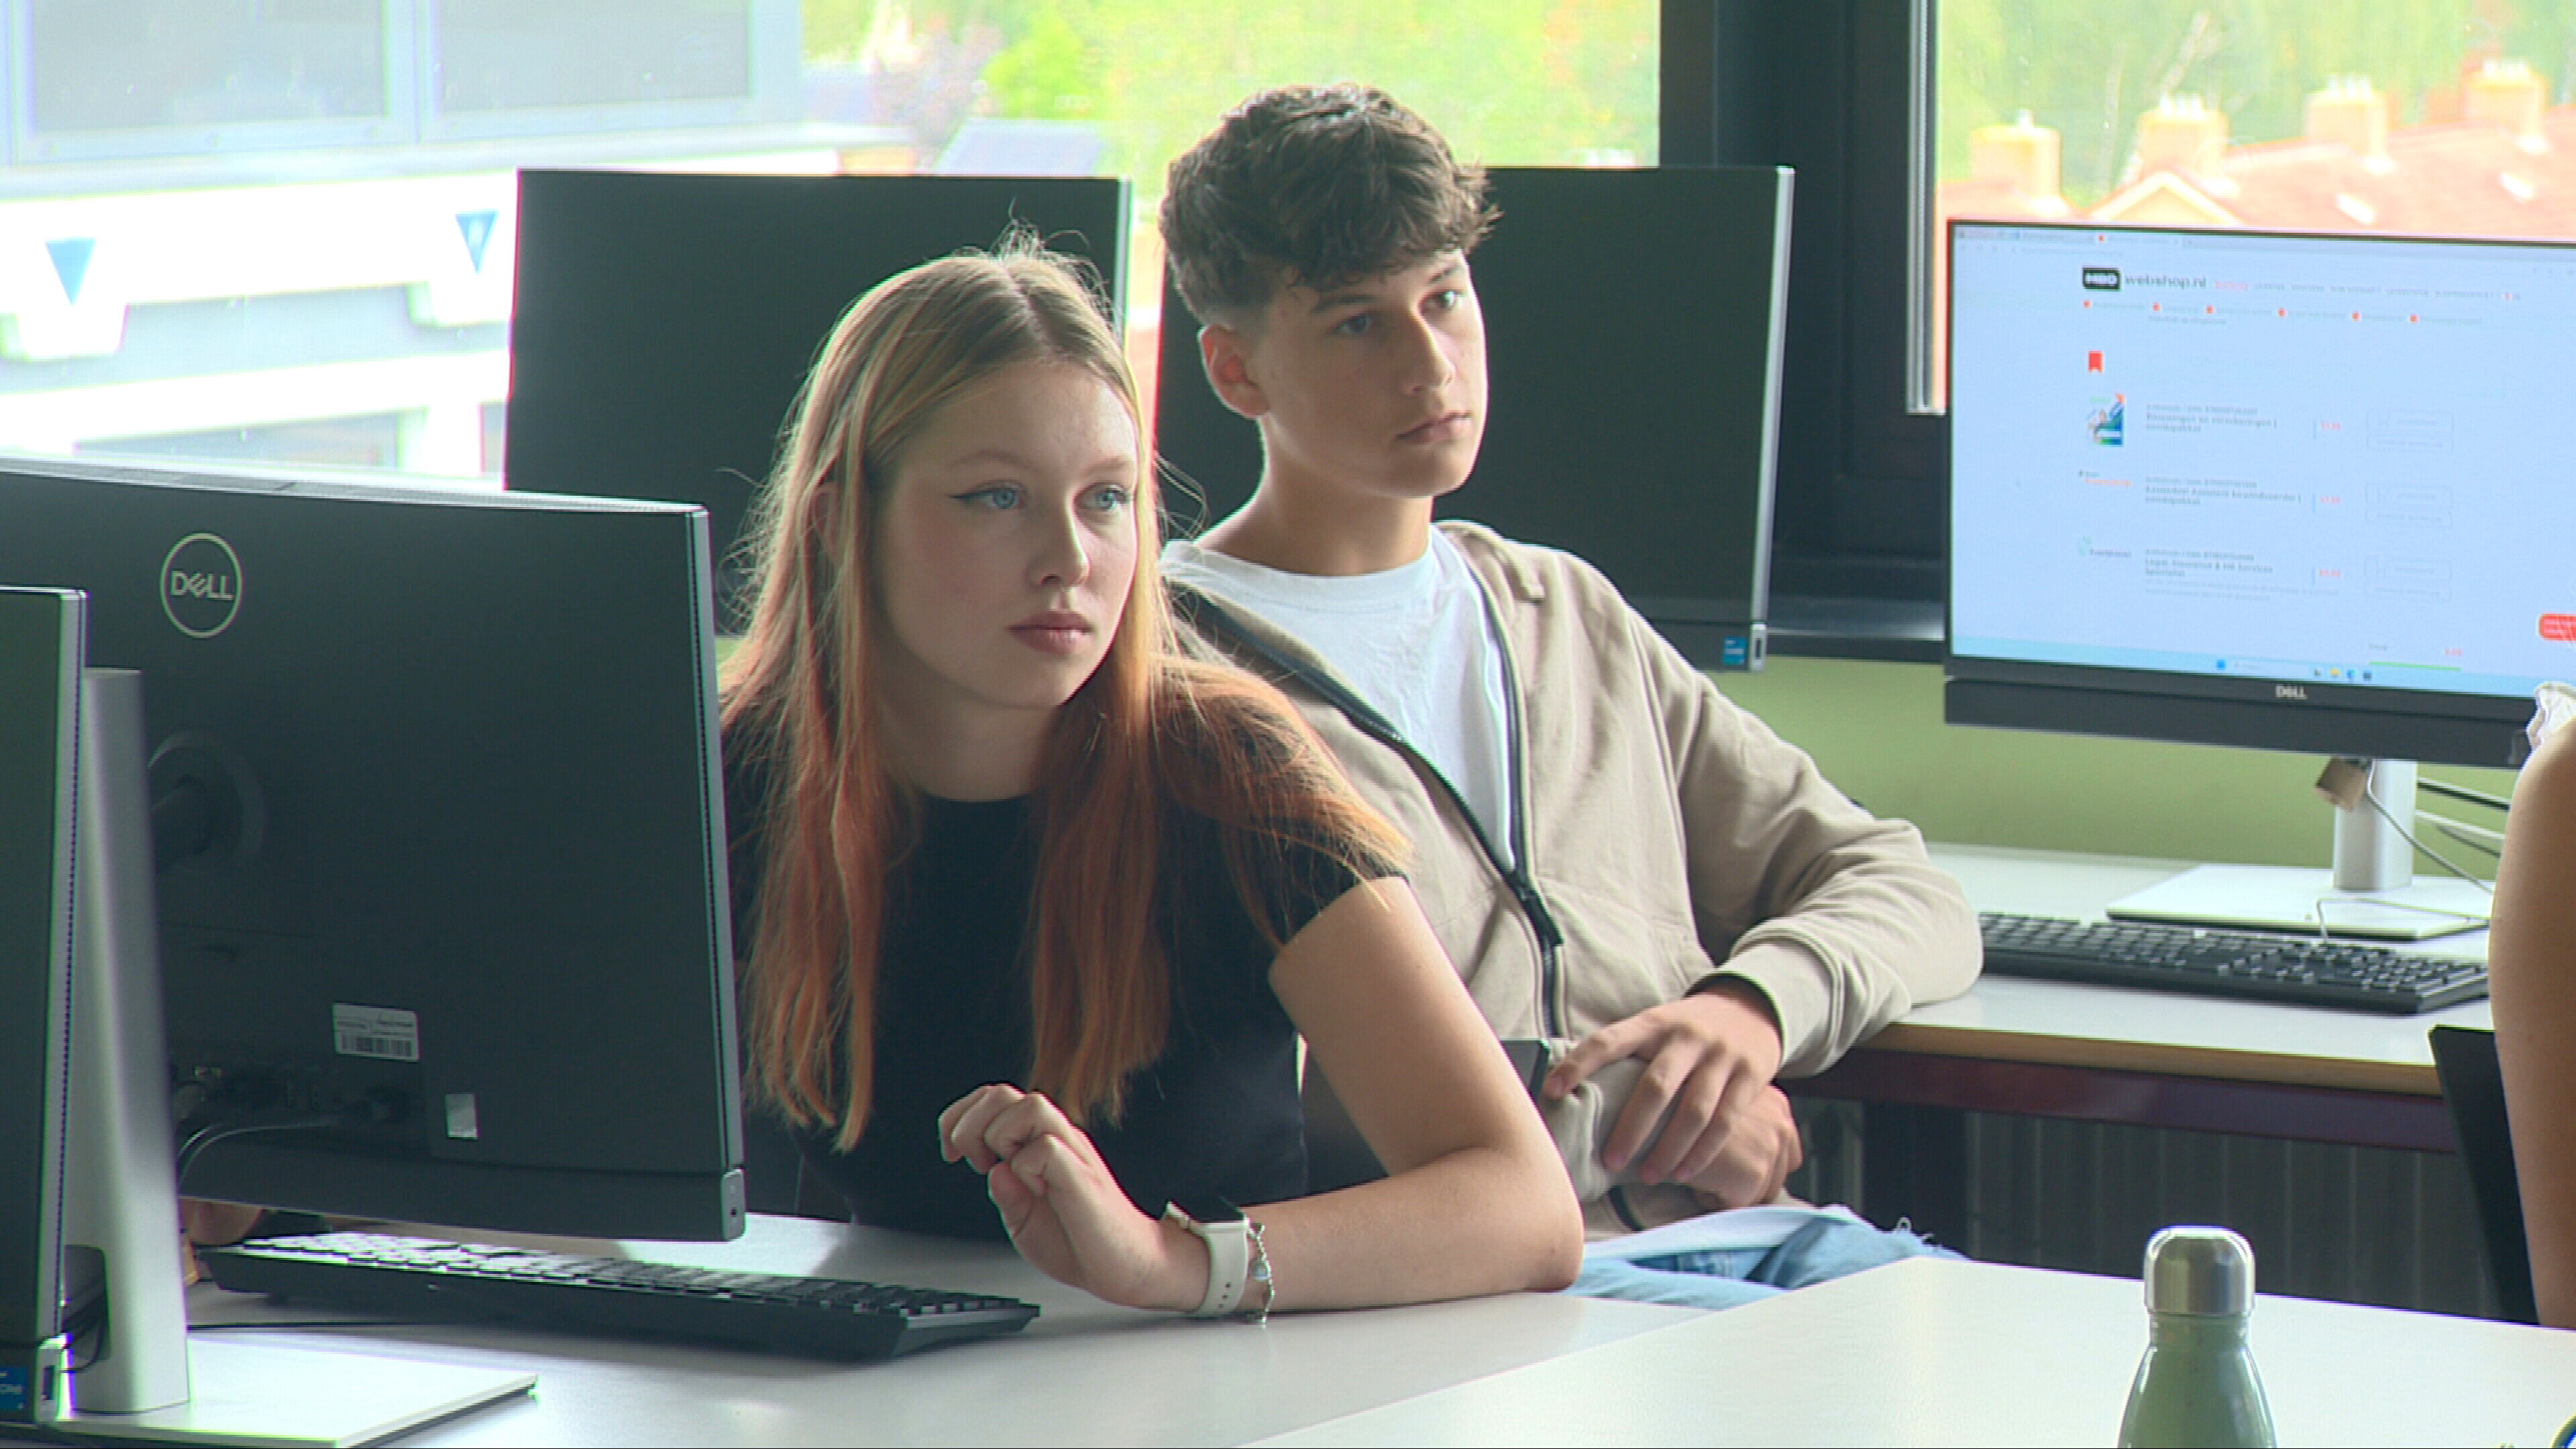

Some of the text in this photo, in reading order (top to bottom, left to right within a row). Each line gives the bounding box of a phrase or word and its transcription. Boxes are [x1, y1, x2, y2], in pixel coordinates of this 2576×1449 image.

[2125, 274, 2207, 290] webshop.nl
[170, 570, 234, 600] DELL
[2275, 684, 2308, 700] DELL
